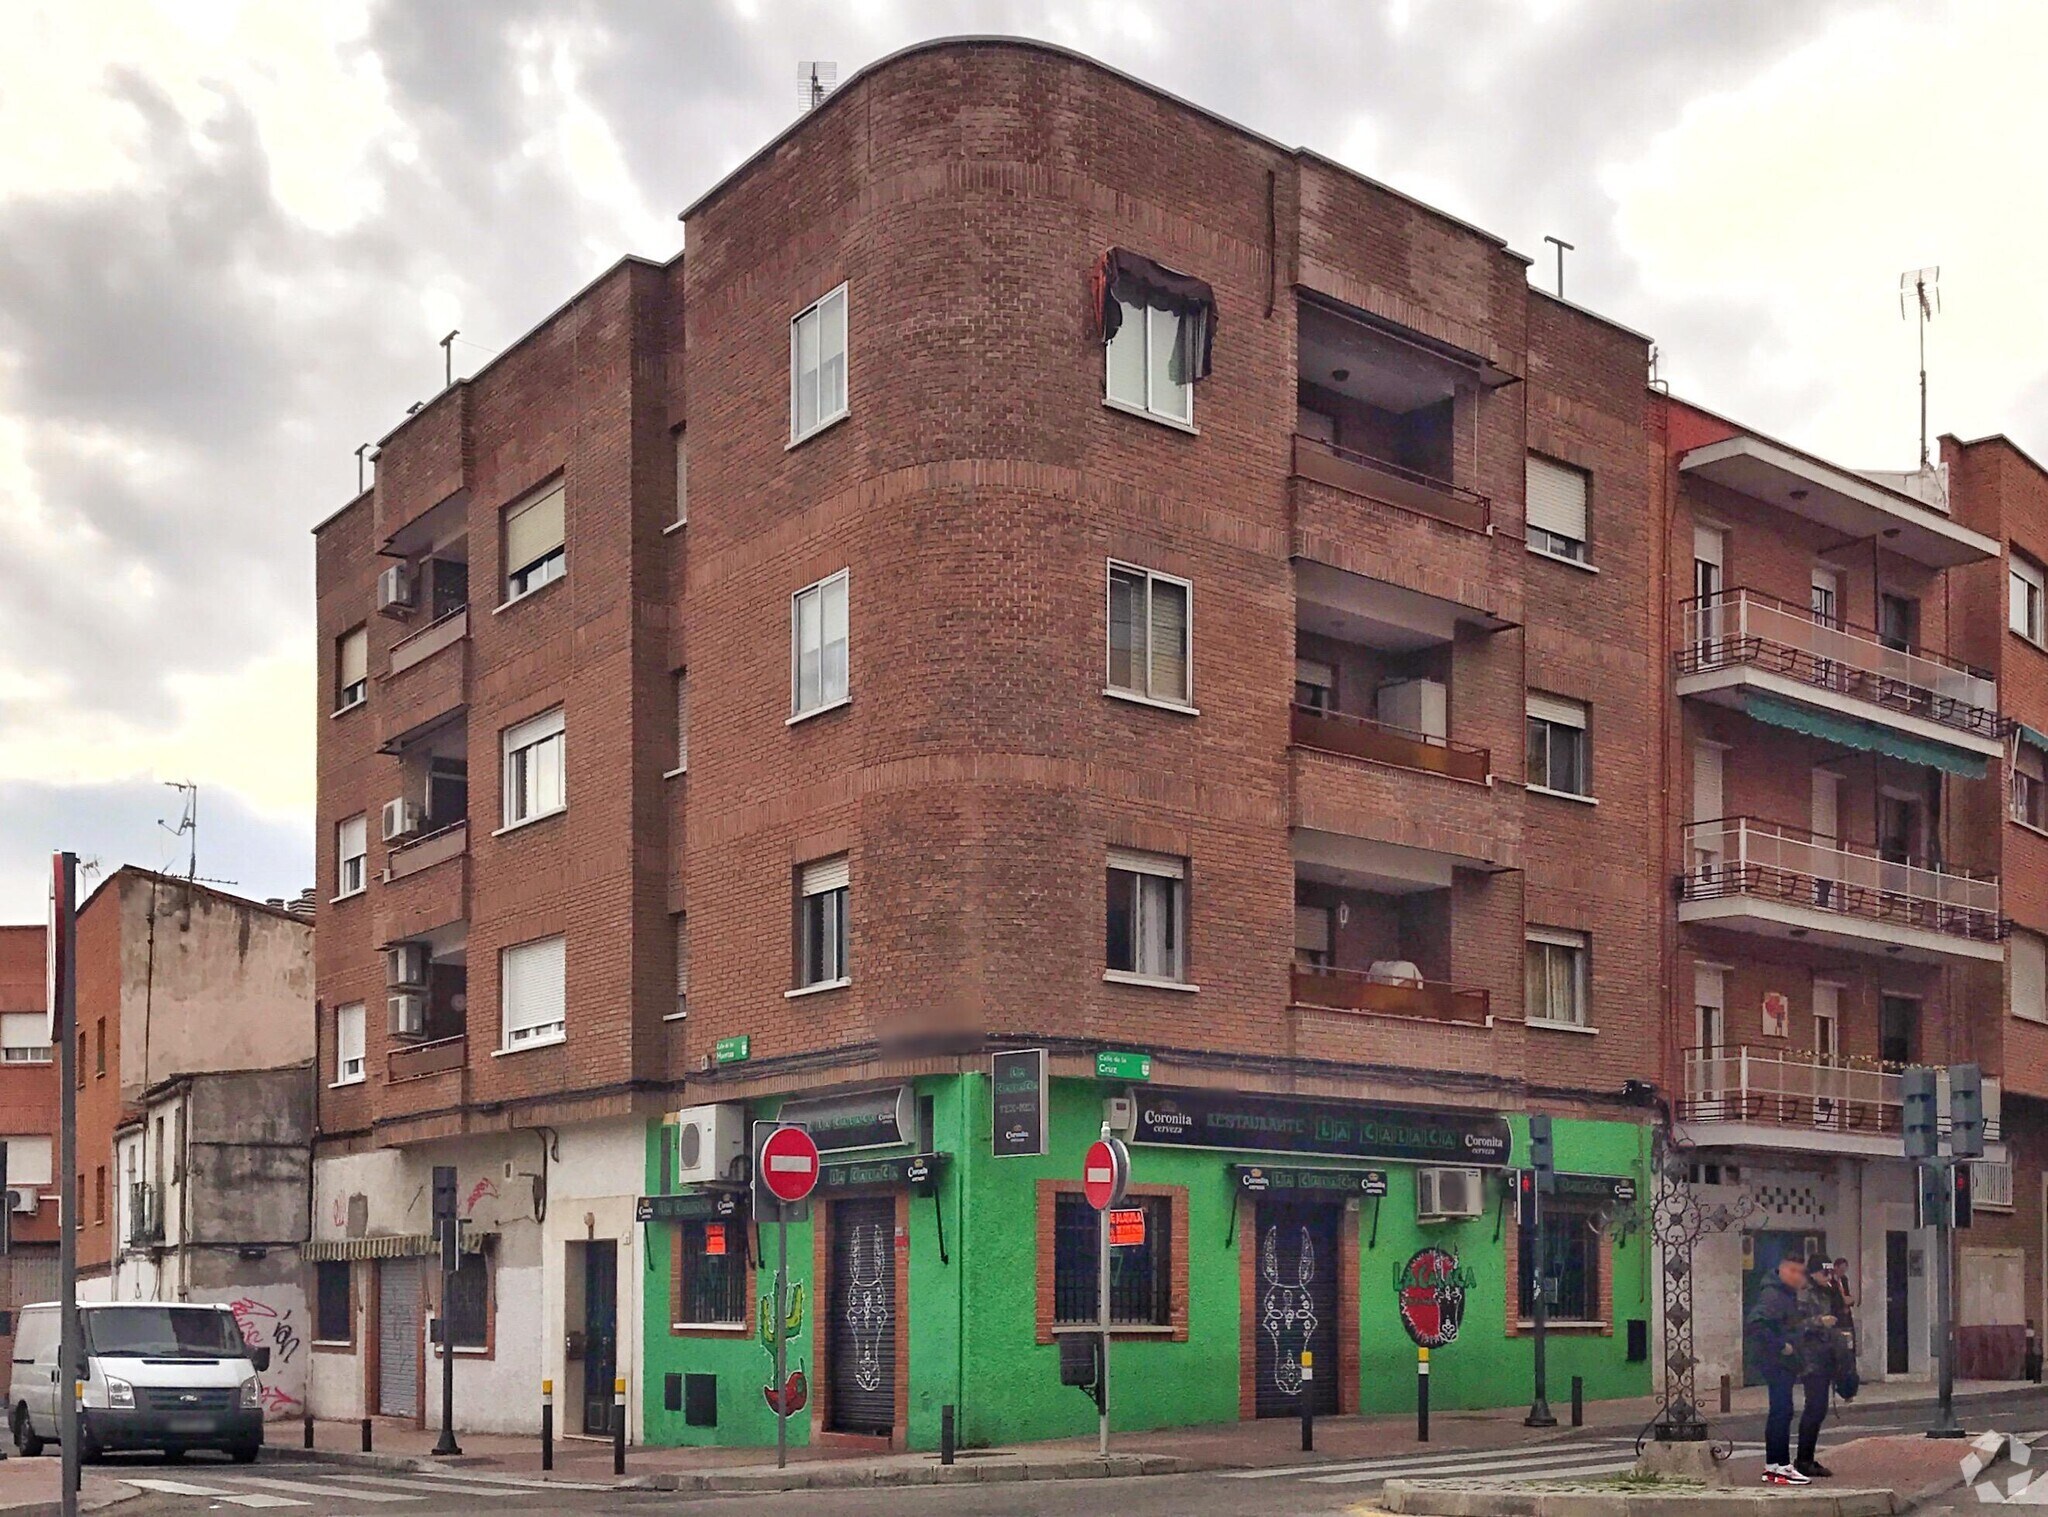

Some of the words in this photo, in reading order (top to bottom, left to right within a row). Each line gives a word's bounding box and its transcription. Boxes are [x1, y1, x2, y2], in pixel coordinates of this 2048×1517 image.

[1098, 1054, 1112, 1062] Calle
[1098, 1063, 1117, 1074] Cruz
[1144, 1109, 1192, 1126] Coronita
[1207, 1112, 1304, 1133] RESTAURANTE
[1153, 1125, 1183, 1134] cerveza
[1465, 1133, 1503, 1148] Coronita
[1471, 1148, 1495, 1156] cerveza
